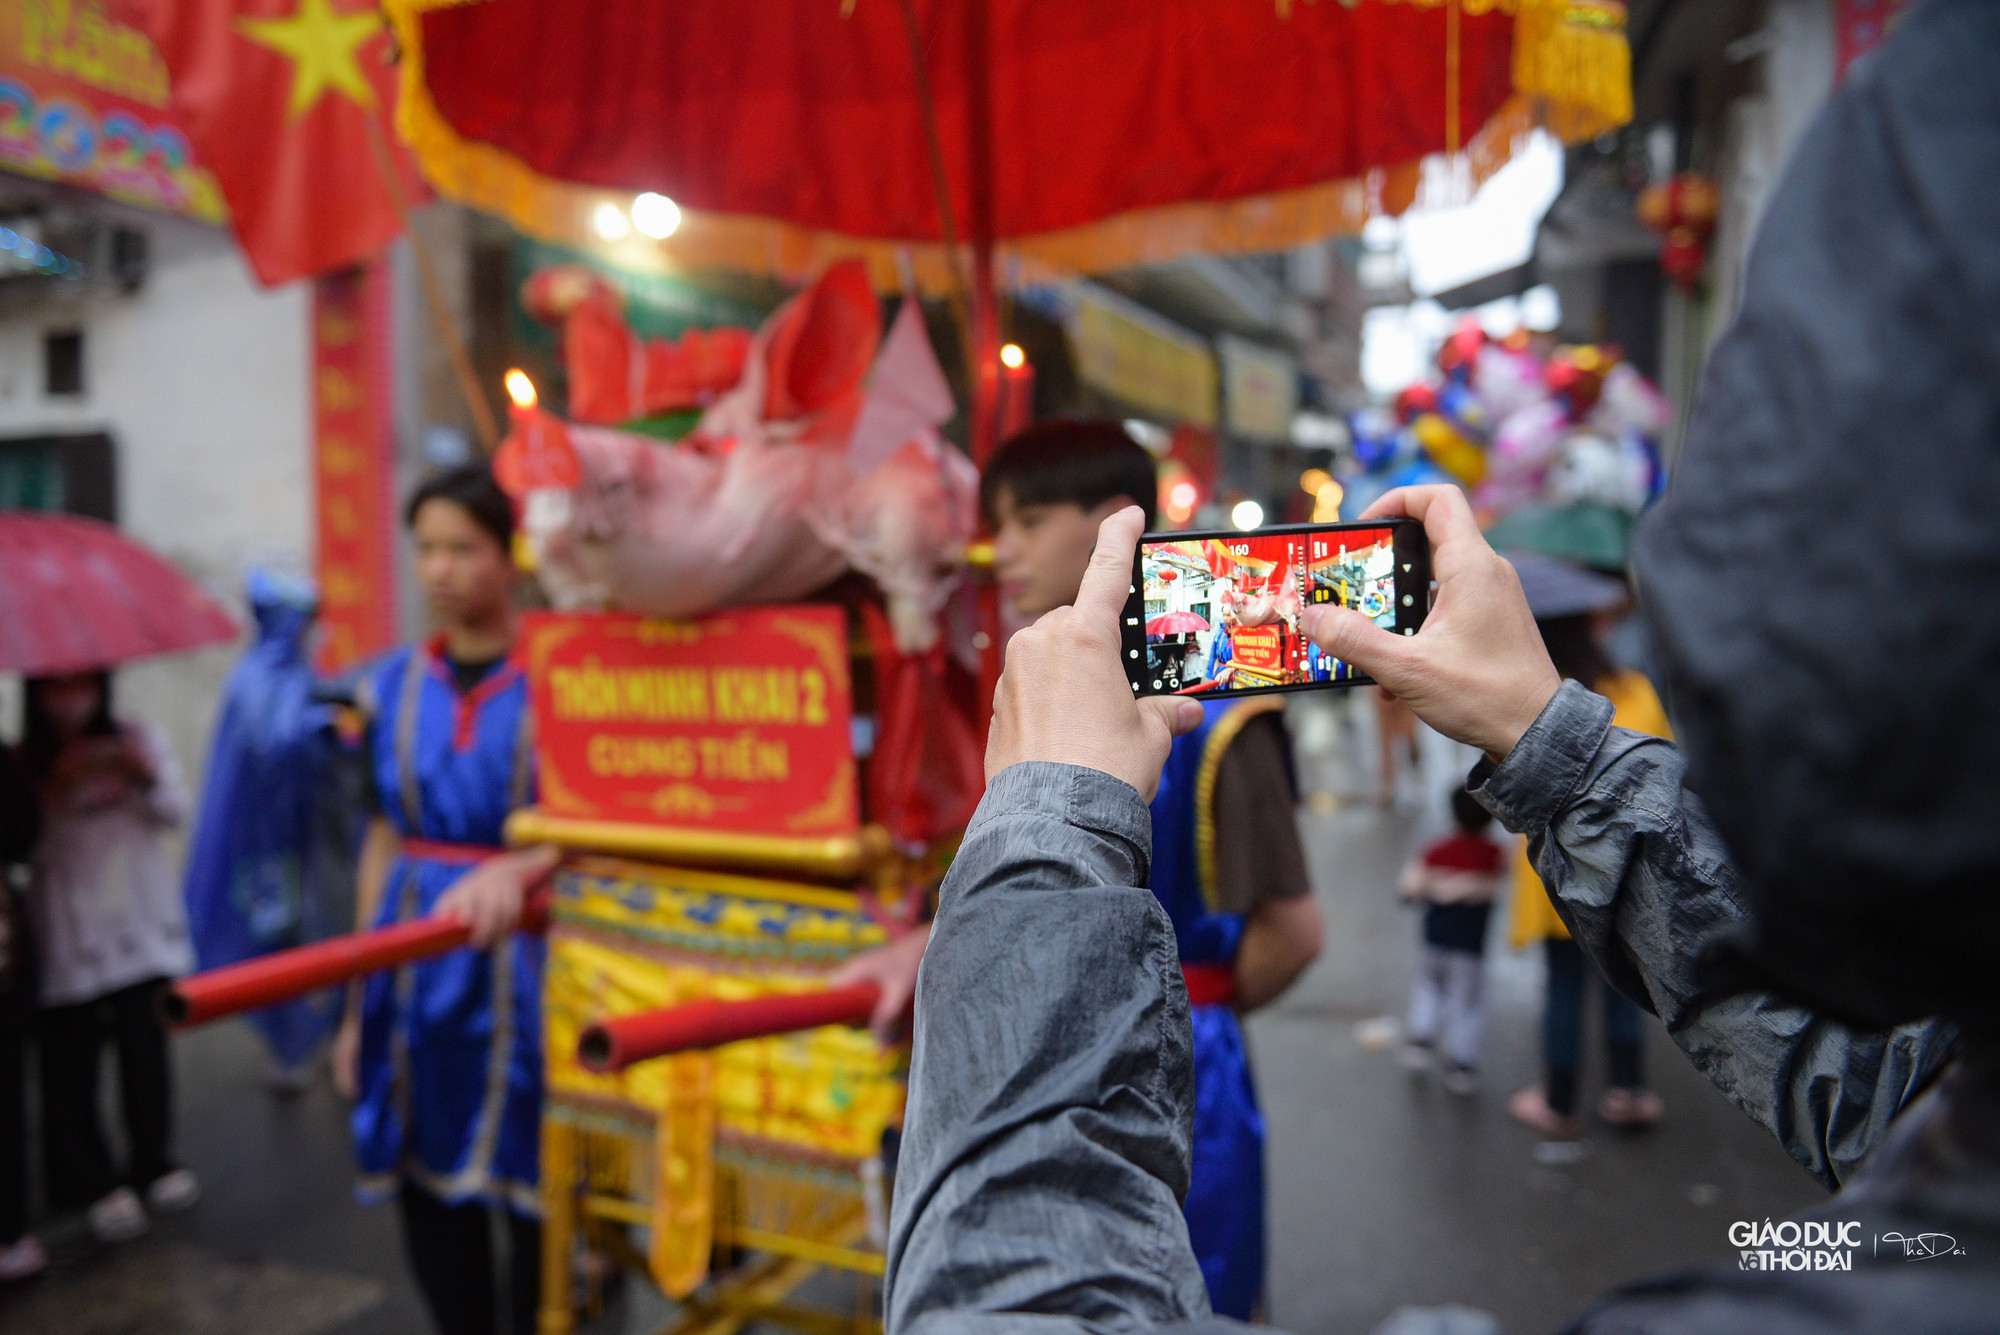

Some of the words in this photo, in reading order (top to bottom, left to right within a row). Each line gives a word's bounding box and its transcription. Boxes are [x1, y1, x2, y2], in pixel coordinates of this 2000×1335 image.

[1229, 544, 1249, 556] 160
[1271, 636, 1276, 648] 2
[618, 666, 709, 722] MINH
[712, 666, 797, 724] KHAI
[800, 667, 829, 726] 2
[587, 733, 697, 779] CUNG
[701, 727, 790, 782] TIẾN
